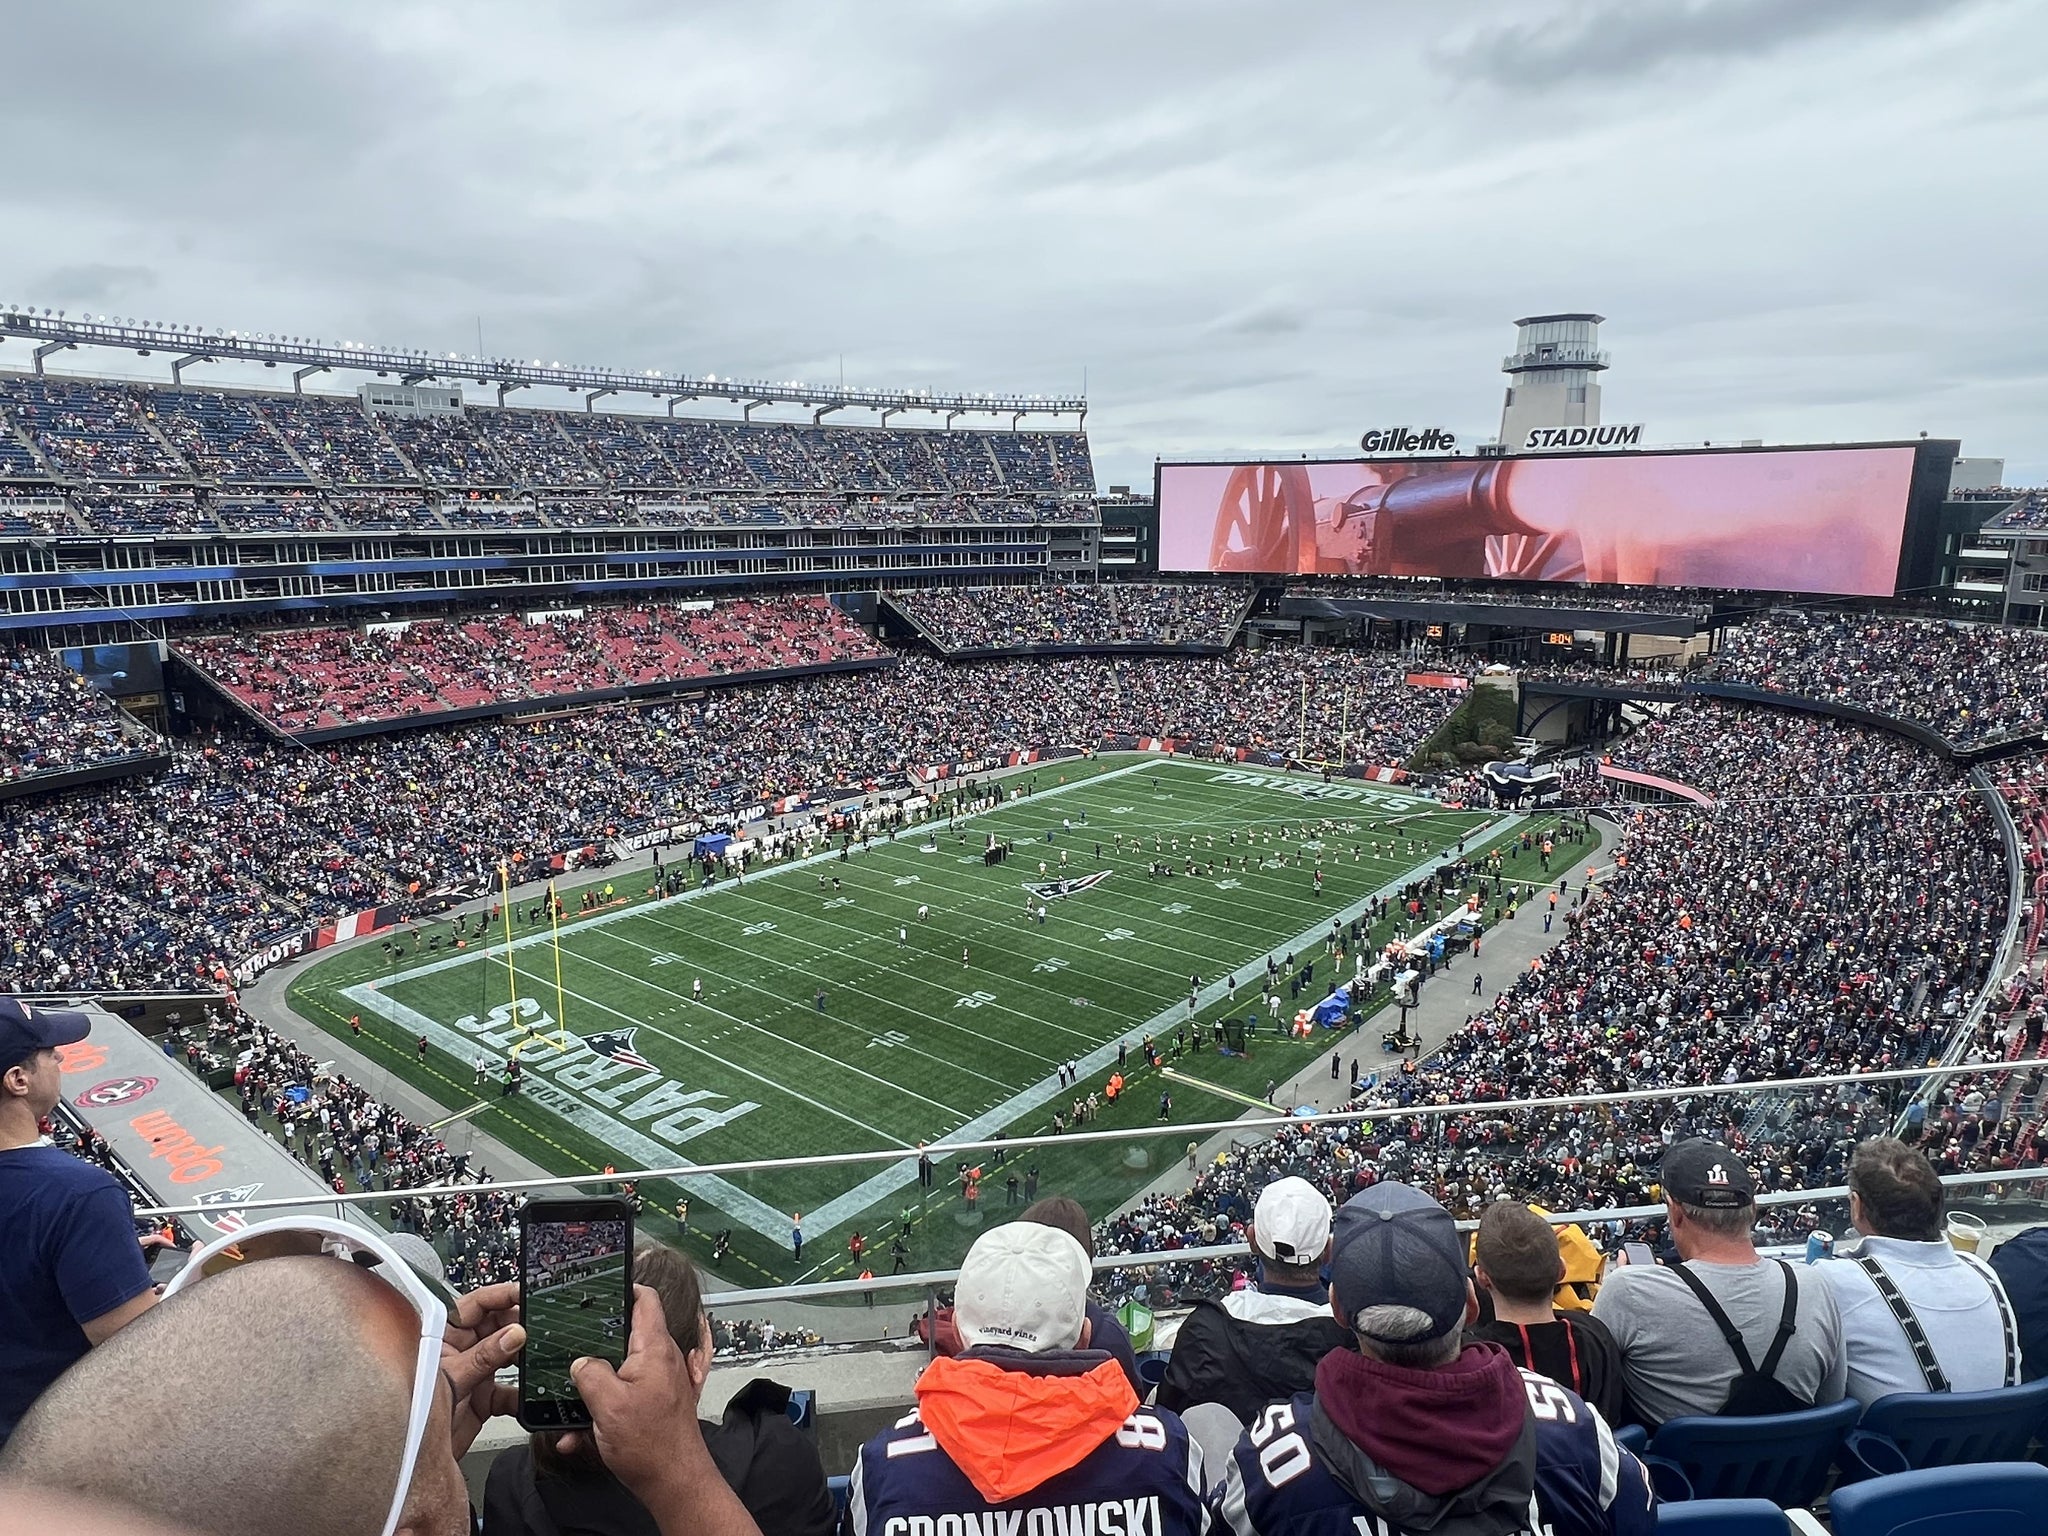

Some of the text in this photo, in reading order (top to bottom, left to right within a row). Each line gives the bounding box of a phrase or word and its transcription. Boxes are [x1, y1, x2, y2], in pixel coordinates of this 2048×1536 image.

[1361, 425, 1641, 451] Gillette STADIUM
[1427, 625, 1442, 637] 25
[1550, 633, 1571, 645] 8:04
[1205, 772, 1419, 811] PATRIOTS
[956, 990, 997, 1008] 20
[871, 1030, 910, 1048] 10
[454, 997, 763, 1146] PATRIOTS
[526, 1086, 582, 1114] STOP
[129, 1108, 225, 1184] Optum
[979, 1325, 1038, 1342] vineyard vines
[1250, 1402, 1312, 1489] 50
